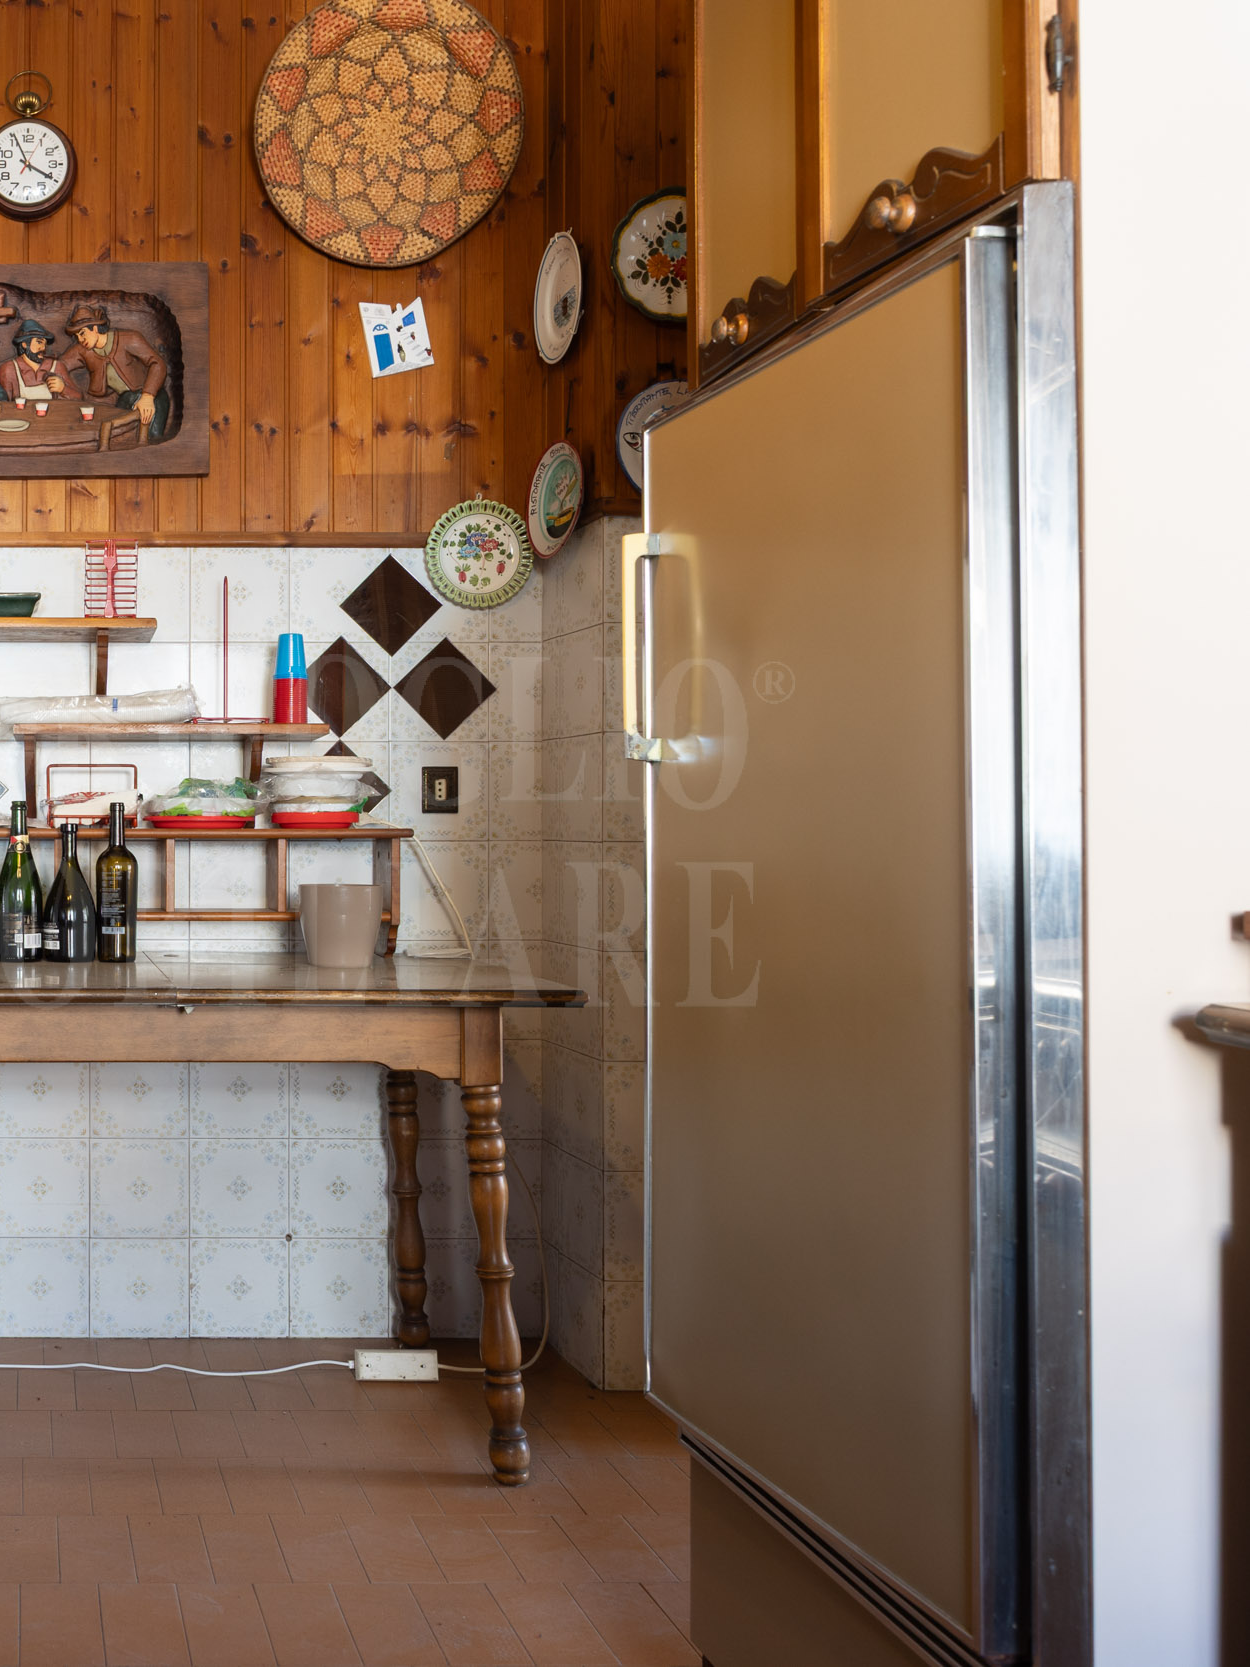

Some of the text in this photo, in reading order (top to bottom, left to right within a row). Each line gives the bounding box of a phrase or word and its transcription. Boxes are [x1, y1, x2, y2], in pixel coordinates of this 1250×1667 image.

[22, 134, 35, 143] 12
[0, 150, 13, 158] 10
[45, 148, 54, 156] 2
[48, 160, 58, 168] 3
[1, 172, 10, 180] 8
[10, 182, 19, 190] 7
[37, 181, 46, 190] 5
